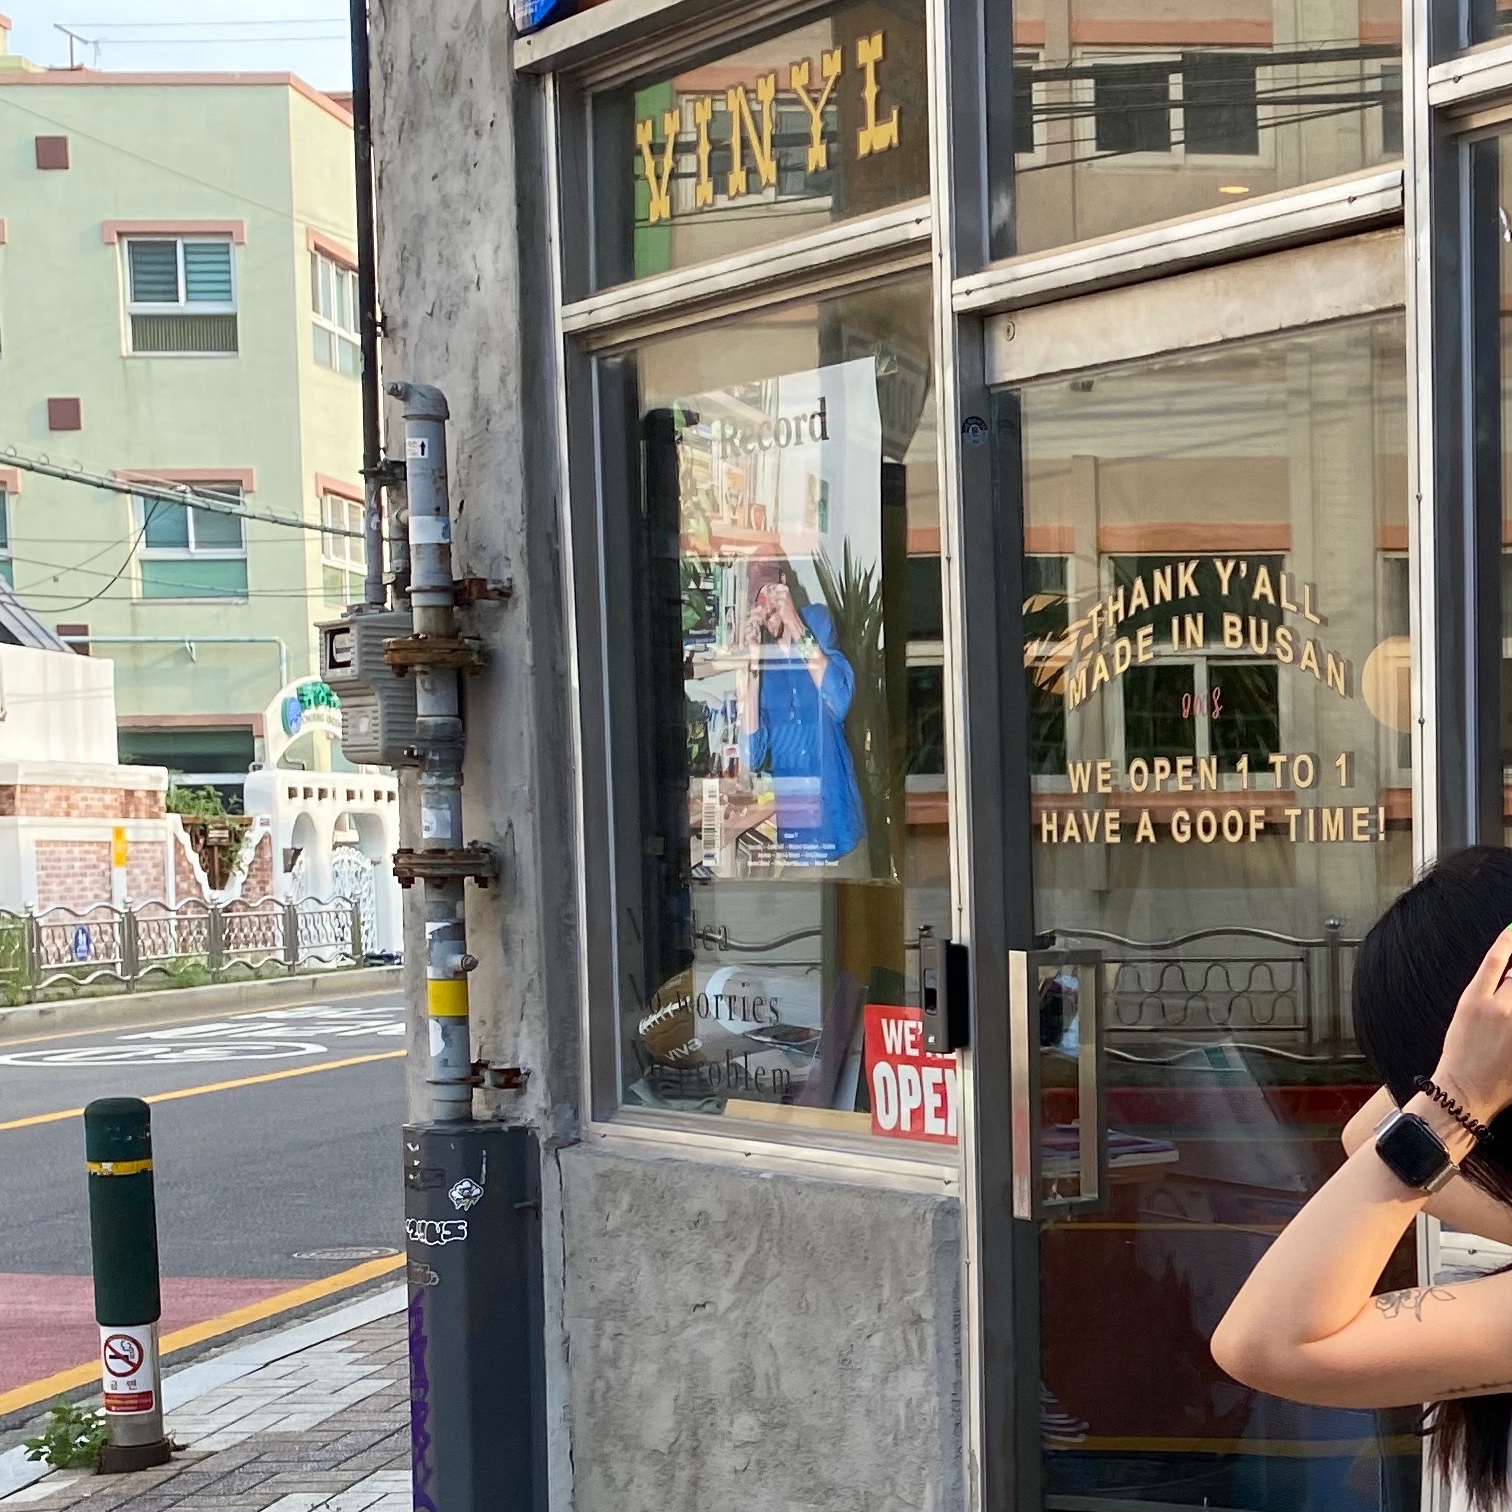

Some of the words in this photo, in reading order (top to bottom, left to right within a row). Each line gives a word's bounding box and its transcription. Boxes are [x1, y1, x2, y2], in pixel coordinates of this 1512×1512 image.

[635, 30, 899, 224] VINYL
[720, 397, 830, 460] Record
[1088, 559, 1200, 639] THANK
[1213, 558, 1322, 625] Y'ALL
[1065, 624, 1155, 710] MADE
[1171, 613, 1204, 651] IN
[1222, 612, 1347, 697] BUSAN
[1067, 760, 1113, 794] WE
[1129, 755, 1218, 792] OPEN
[1235, 753, 1250, 790] 1
[1268, 752, 1315, 790] TO
[1334, 752, 1349, 788] 1
[1040, 809, 1121, 843] HAVE
[1135, 809, 1157, 843] A
[1171, 809, 1267, 843] GOOF
[1285, 806, 1386, 842] TIME!
[881, 1018, 957, 1060] WE'
